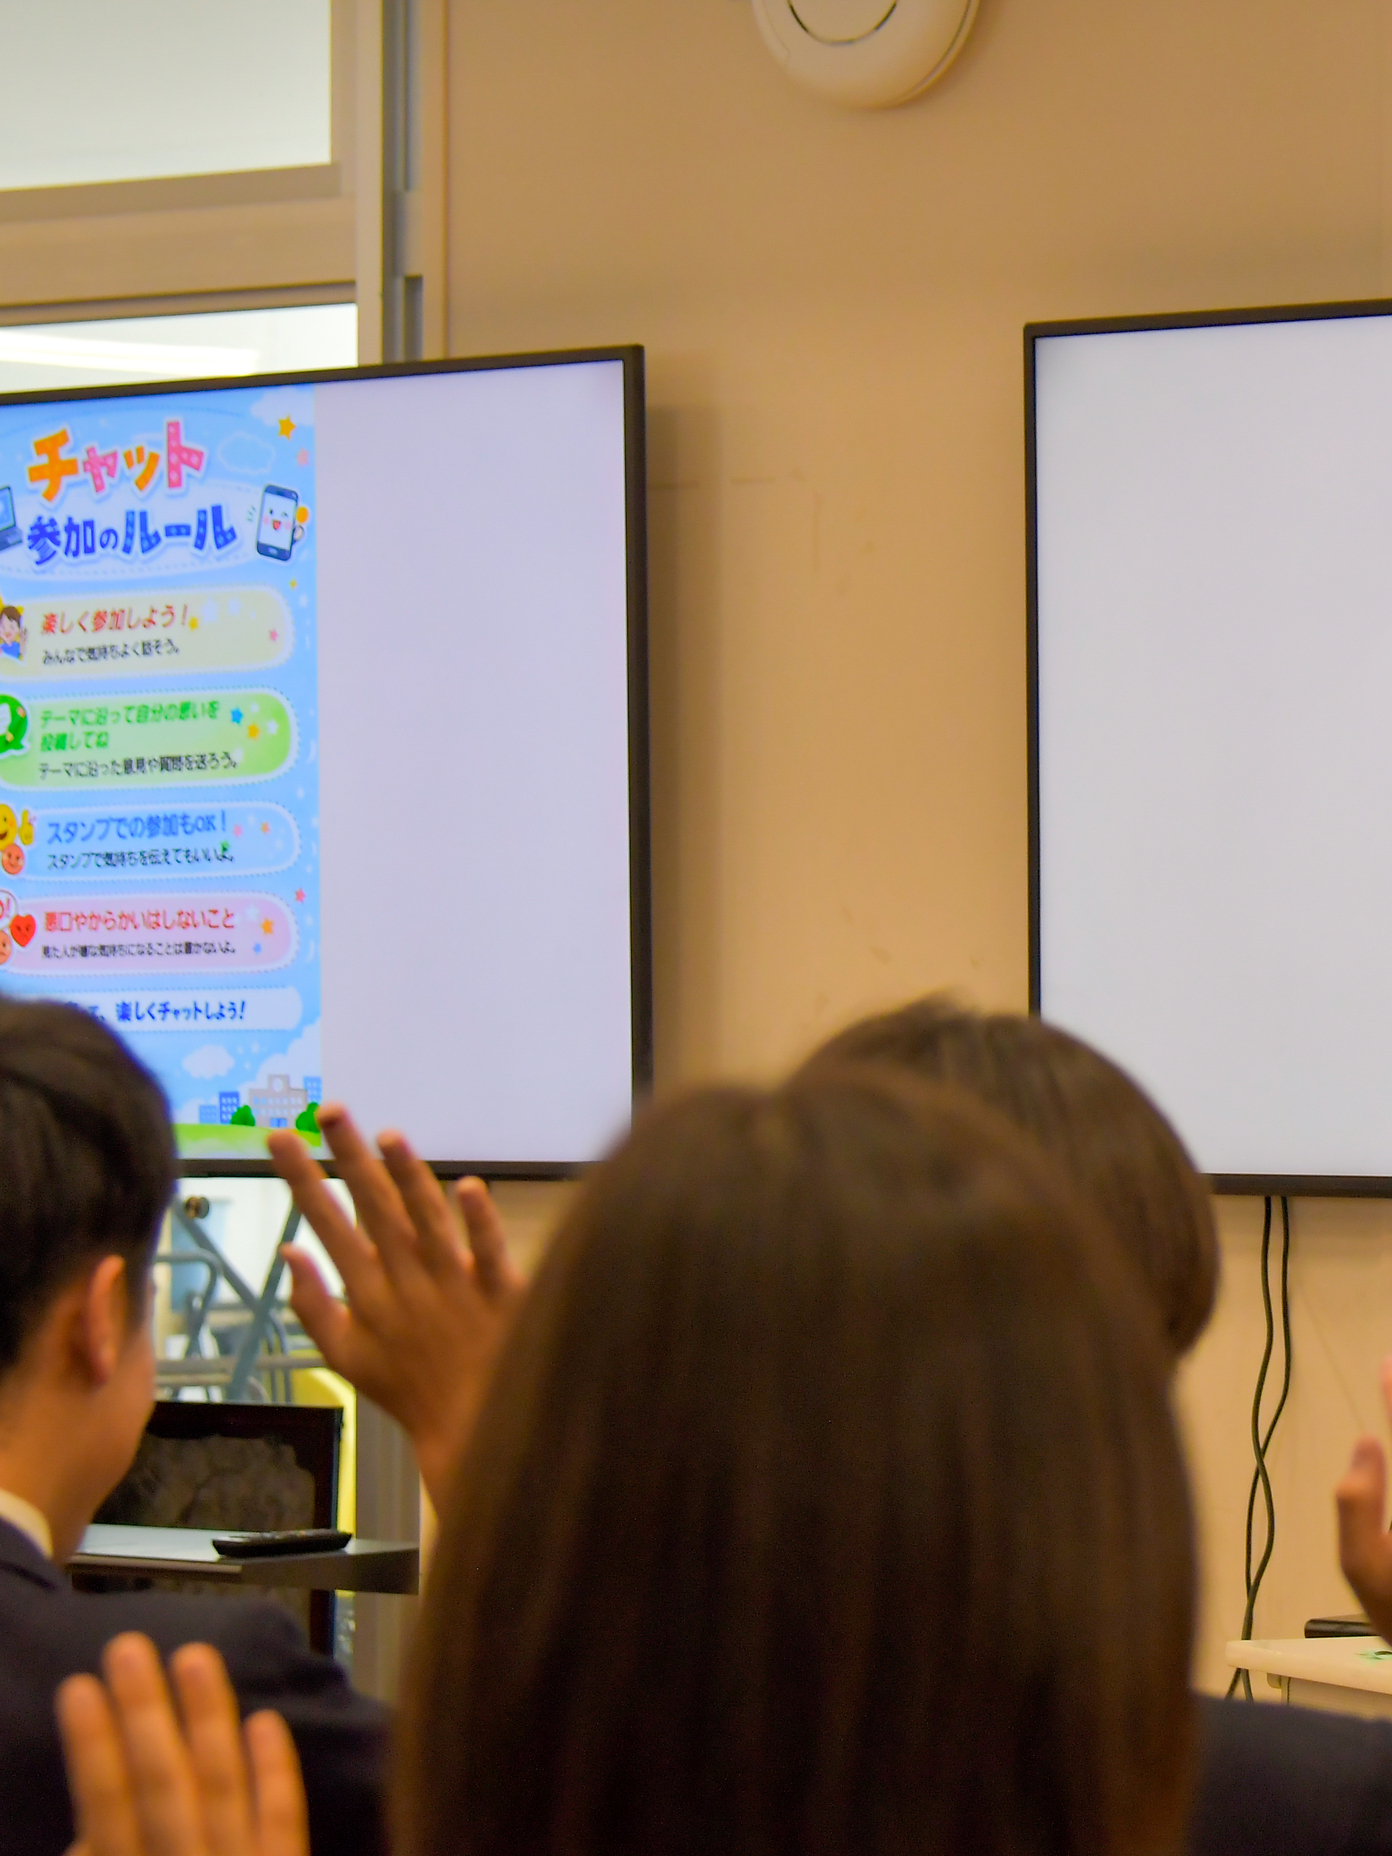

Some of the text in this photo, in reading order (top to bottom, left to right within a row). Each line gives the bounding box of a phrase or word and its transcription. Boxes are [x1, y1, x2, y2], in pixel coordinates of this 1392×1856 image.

[28, 421, 204, 502] チャット
[28, 505, 237, 565] 参加のルール
